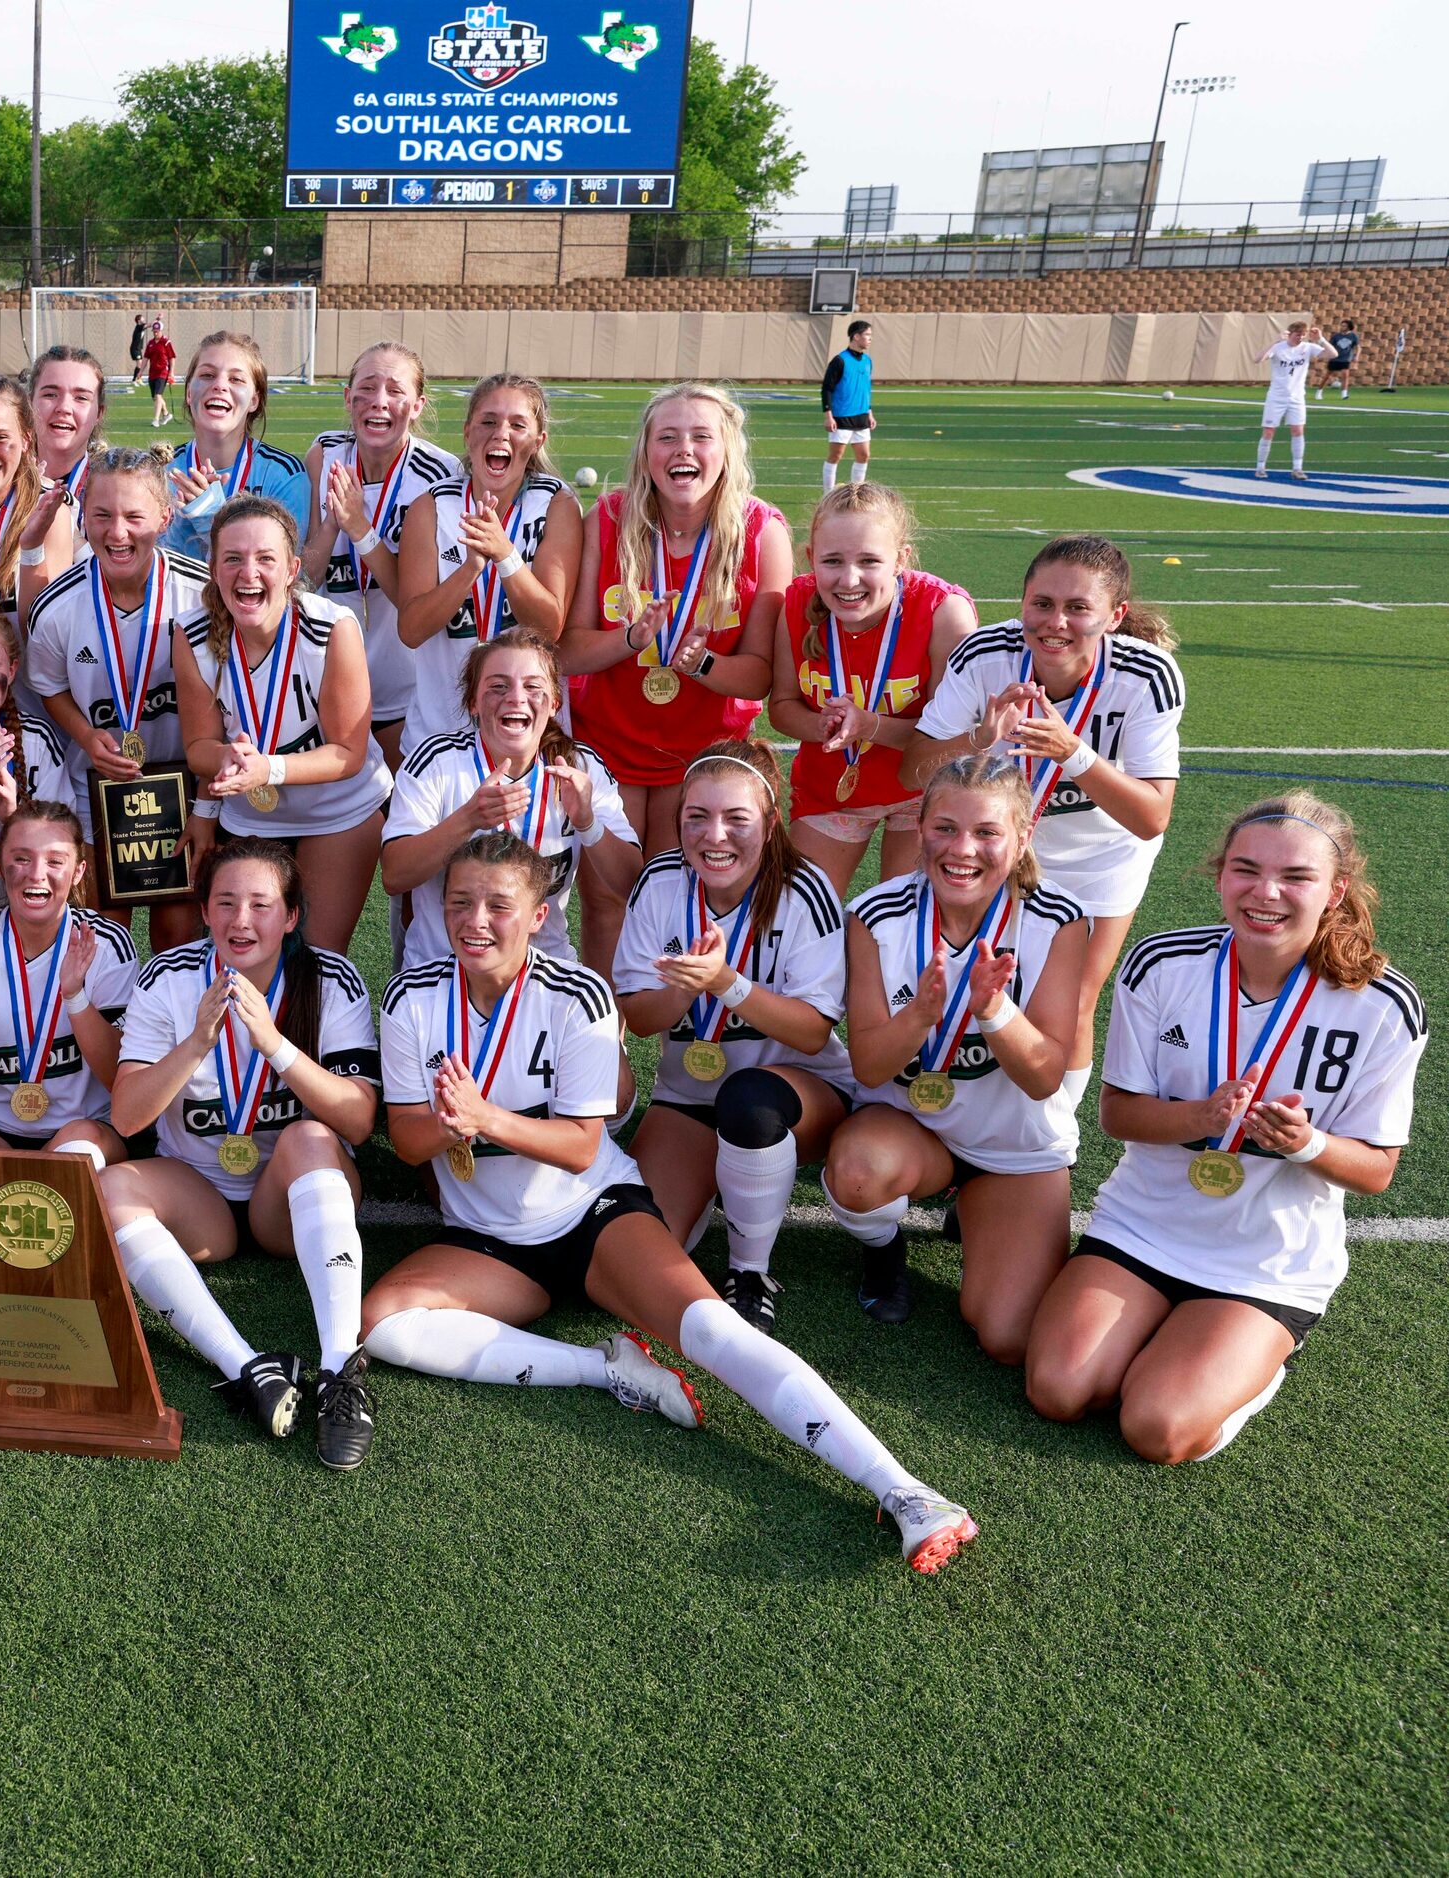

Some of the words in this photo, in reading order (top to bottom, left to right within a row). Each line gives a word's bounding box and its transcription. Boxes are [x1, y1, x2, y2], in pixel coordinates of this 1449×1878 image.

[466, 31, 511, 39] SOCCER
[433, 39, 542, 60] STATE
[453, 60, 521, 68] CHAMPIONSHIPS
[353, 93, 379, 106] 6A
[383, 93, 437, 106] GIRLS
[441, 93, 495, 106] STATE
[500, 93, 619, 106] CHAMPIONS
[335, 115, 499, 134] SOUTHLAKE
[507, 115, 631, 134] CARROLL
[399, 139, 563, 162] DRAGONS
[304, 178, 321, 190] SOG
[351, 178, 378, 190] SAVES
[581, 178, 607, 190] SAVES
[637, 178, 655, 190] SOG
[309, 191, 316, 203] 0
[360, 191, 368, 203] 0
[443, 181, 495, 201] PERIOD
[505, 181, 514, 201] 1
[589, 191, 597, 203] 0
[641, 191, 649, 203] 0
[75, 656, 99, 664] adidas
[1091, 711, 1125, 760] 17
[123, 790, 162, 817] UIL
[129, 827, 180, 838] Championships
[116, 838, 177, 864] MVP
[143, 878, 159, 886] 2022
[1159, 1035, 1189, 1049] adidas
[527, 1031, 554, 1089] 4
[1293, 1025, 1359, 1093] 18
[186, 1099, 301, 1131] CAOLL
[595, 1198, 618, 1216] adidas
[8, 1239, 46, 1250] STATE
[48, 1226, 72, 1261] LEAGUE
[325, 1260, 356, 1270] adidas
[0, 1303, 68, 1328] INTERSCHOLASTIC
[67, 1324, 91, 1351] LEAGUE
[17, 1341, 61, 1351] CHAMPION
[23, 1351, 57, 1361] SOCCER
[37, 1362, 71, 1372] AAAAAA
[16, 1387, 38, 1395] 2022
[809, 1420, 831, 1449] adidas
